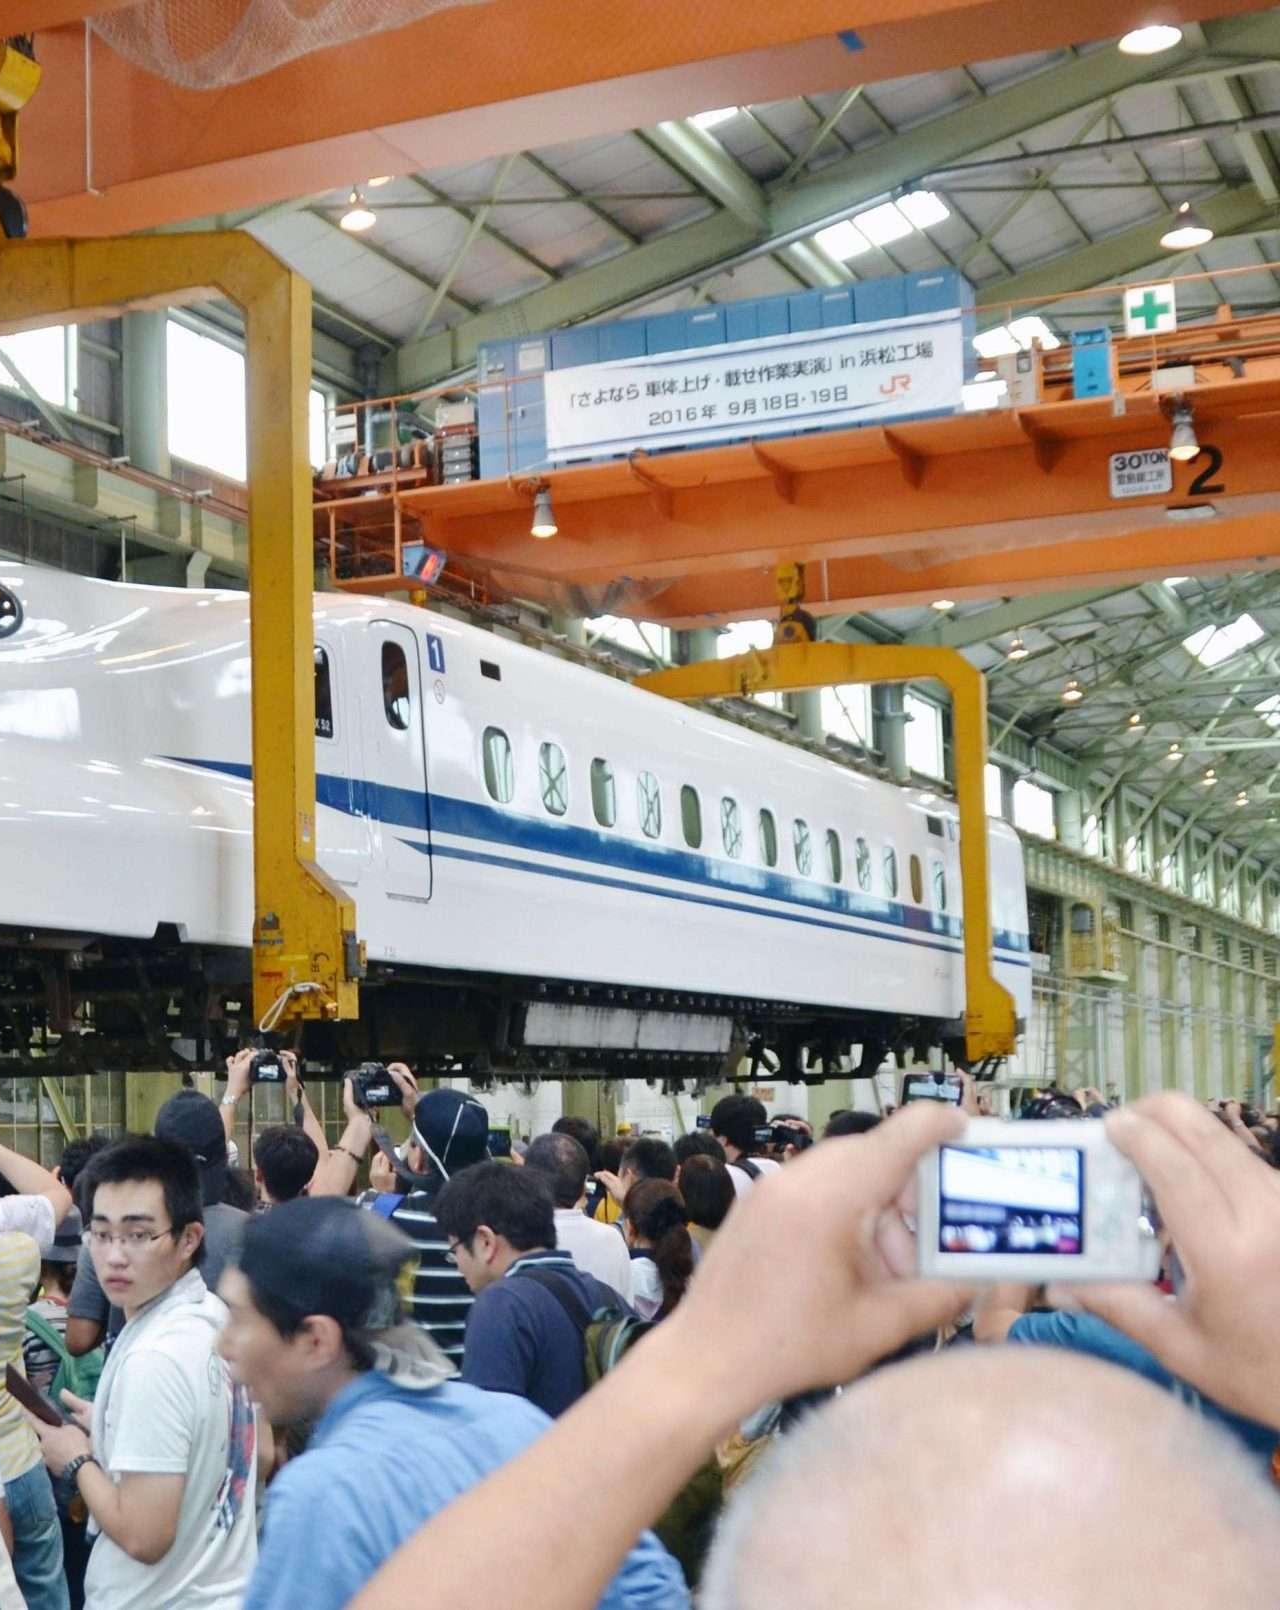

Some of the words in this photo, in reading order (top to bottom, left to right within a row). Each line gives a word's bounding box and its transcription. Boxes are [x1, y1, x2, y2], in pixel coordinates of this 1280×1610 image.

[570, 383, 640, 408] 「さよなら
[840, 353, 856, 369] in
[860, 341, 934, 367] 浜松工場
[879, 374, 912, 395] JR
[1185, 444, 1225, 496] 2
[431, 639, 441, 670] 1
